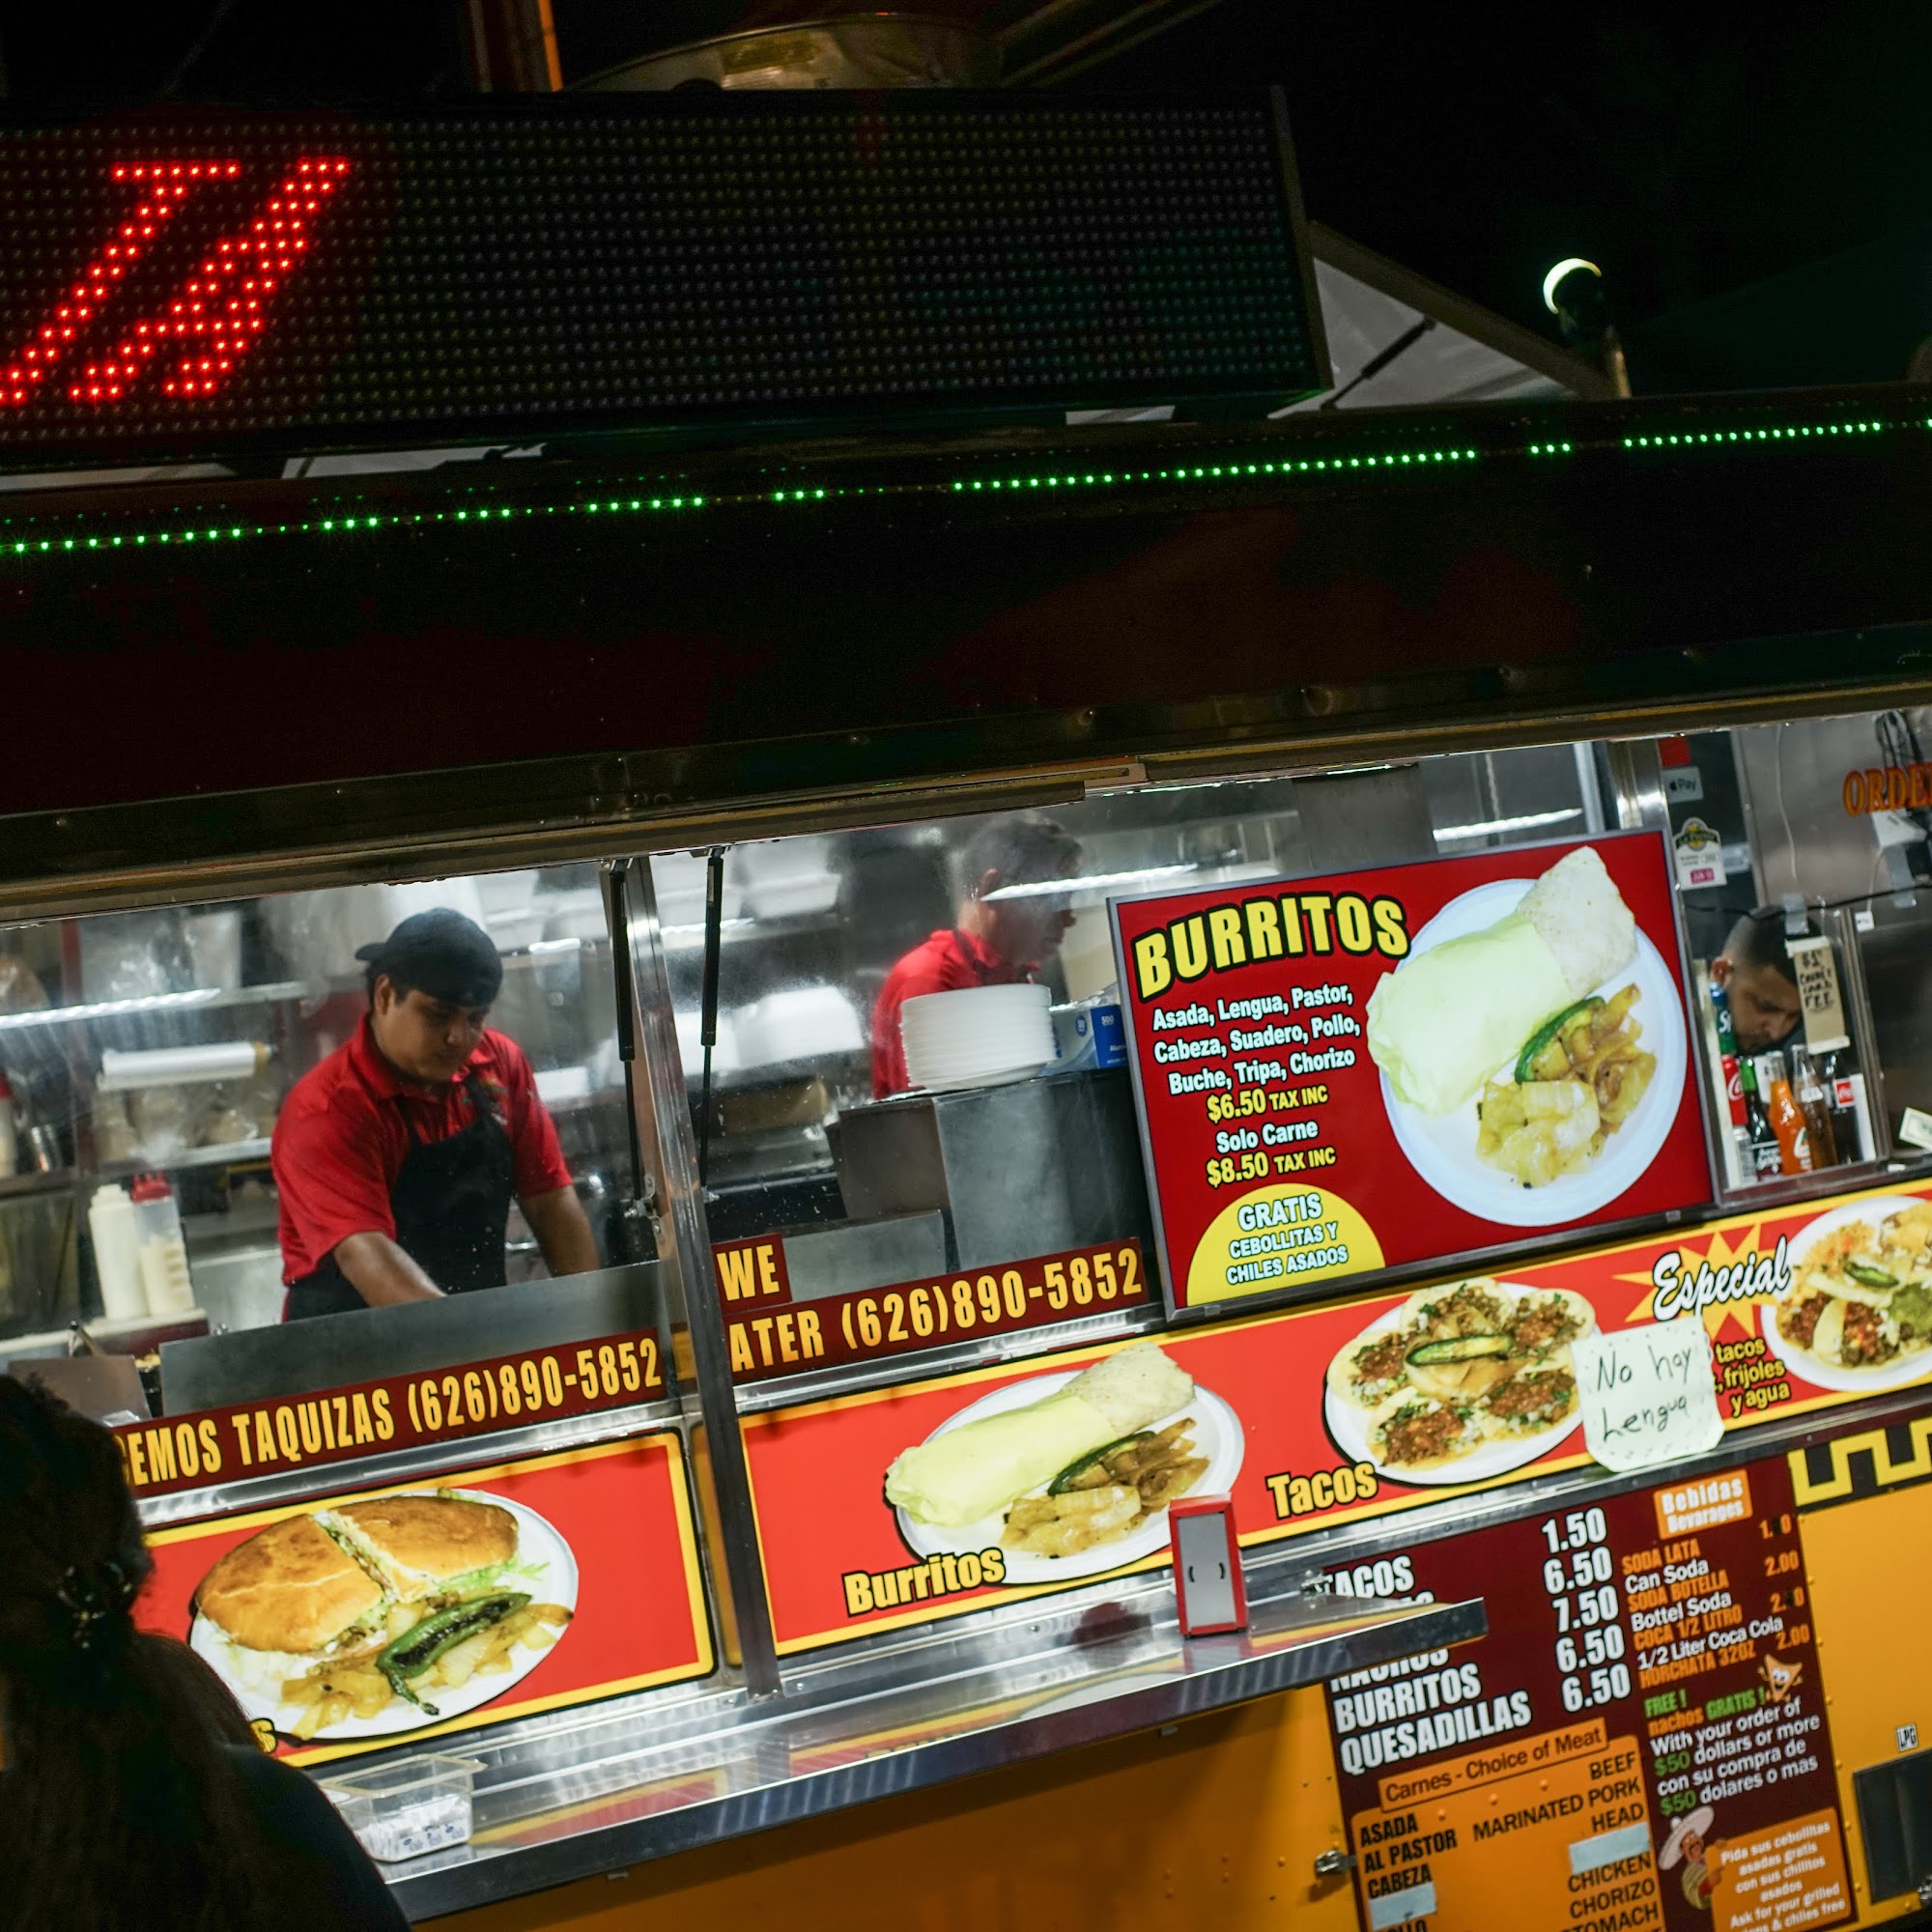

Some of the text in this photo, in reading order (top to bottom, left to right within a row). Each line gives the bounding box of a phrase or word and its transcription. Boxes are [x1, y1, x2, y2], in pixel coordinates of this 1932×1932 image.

[1678, 779, 1696, 794] Pay
[1843, 761, 1932, 817] ORDE
[1133, 894, 1410, 1001] BURRITOS
[1153, 983, 1352, 1031] Asada, Lengua, Pastor,
[1153, 1014, 1360, 1064] Cabeza, Suadero, Pollo,
[1168, 1048, 1354, 1095] Buche, Tripa, Chorizo
[1207, 1085, 1328, 1123] $6.50 TAX INC
[1216, 1120, 1319, 1153] Solo Carne
[1207, 1147, 1336, 1188] $8.50 TAX INC
[1237, 1193, 1323, 1232] GRATIS
[1229, 1221, 1338, 1259] CEBOLLITAS Y
[717, 1244, 780, 1302] WE
[1226, 1245, 1349, 1286] CHILES ASADOS
[1653, 1236, 1791, 1321] Especial
[840, 1247, 1143, 1350] (626)890-5852
[1598, 1350, 1633, 1391] No
[1715, 1338, 1766, 1364] tacos
[1723, 1358, 1785, 1389] frijoles
[114, 1337, 663, 1486] EMOS TAQUIZAS (626)890-5852
[1602, 1395, 1690, 1443] Lengua
[1730, 1394, 1743, 1418] y
[1745, 1382, 1791, 1409] agua
[1266, 1462, 1378, 1520] Tacos
[1662, 1478, 1743, 1515] Bebidas
[1542, 1508, 1607, 1553] 1.50
[1622, 1514, 1792, 1576] SODA LATA 1.0
[843, 1547, 1007, 1617] Burritos
[1543, 1546, 1613, 1594] 6.50
[1625, 1558, 1709, 1595] Can Soda
[1628, 1549, 1800, 1613] SODA BOTELLA 2.00
[1552, 1585, 1620, 1633] 7.50
[1631, 1591, 1732, 1633] Bottel Soda
[1633, 1586, 1805, 1652] COCA 1/2 LITRO 2.0
[1636, 1616, 1783, 1671] 1/2 Liter Coca Cola
[1776, 1623, 1810, 1650] 2.00
[1333, 1663, 1482, 1734] BURRITOS
[1556, 1624, 1627, 1673] 6.50
[1340, 1662, 1632, 1776] QUESADILLAS 6.50
[1644, 1691, 1678, 1719] FREE
[1647, 1707, 1704, 1737] nachos
[1705, 1690, 1757, 1720] GRATIS
[1650, 1695, 1801, 1756] With your order of
[1654, 1715, 1821, 1777] $50 dollars or more
[1898, 1727, 1917, 1747] LPG
[1385, 1768, 1453, 1803] Carnes
[1465, 1750, 1528, 1781] Choice
[1532, 1740, 1551, 1763] of
[1556, 1728, 1603, 1756] Meat
[1657, 1738, 1806, 1797] con su compra de
[1660, 1754, 1818, 1816] $50 dolares o mas
[1359, 1751, 1637, 1848] ASADA BEEF
[1365, 1777, 1642, 1873] AL PASTOR MARINATED PORK
[1750, 1839, 1773, 1856] sus
[1368, 1803, 1645, 1899] CABEZA HEAD
[1568, 1852, 1652, 1892] CHICKEN
[1570, 1878, 1655, 1918] CHORIZO
[1754, 1905, 1773, 1920] for
[1775, 1896, 1801, 1916] your
